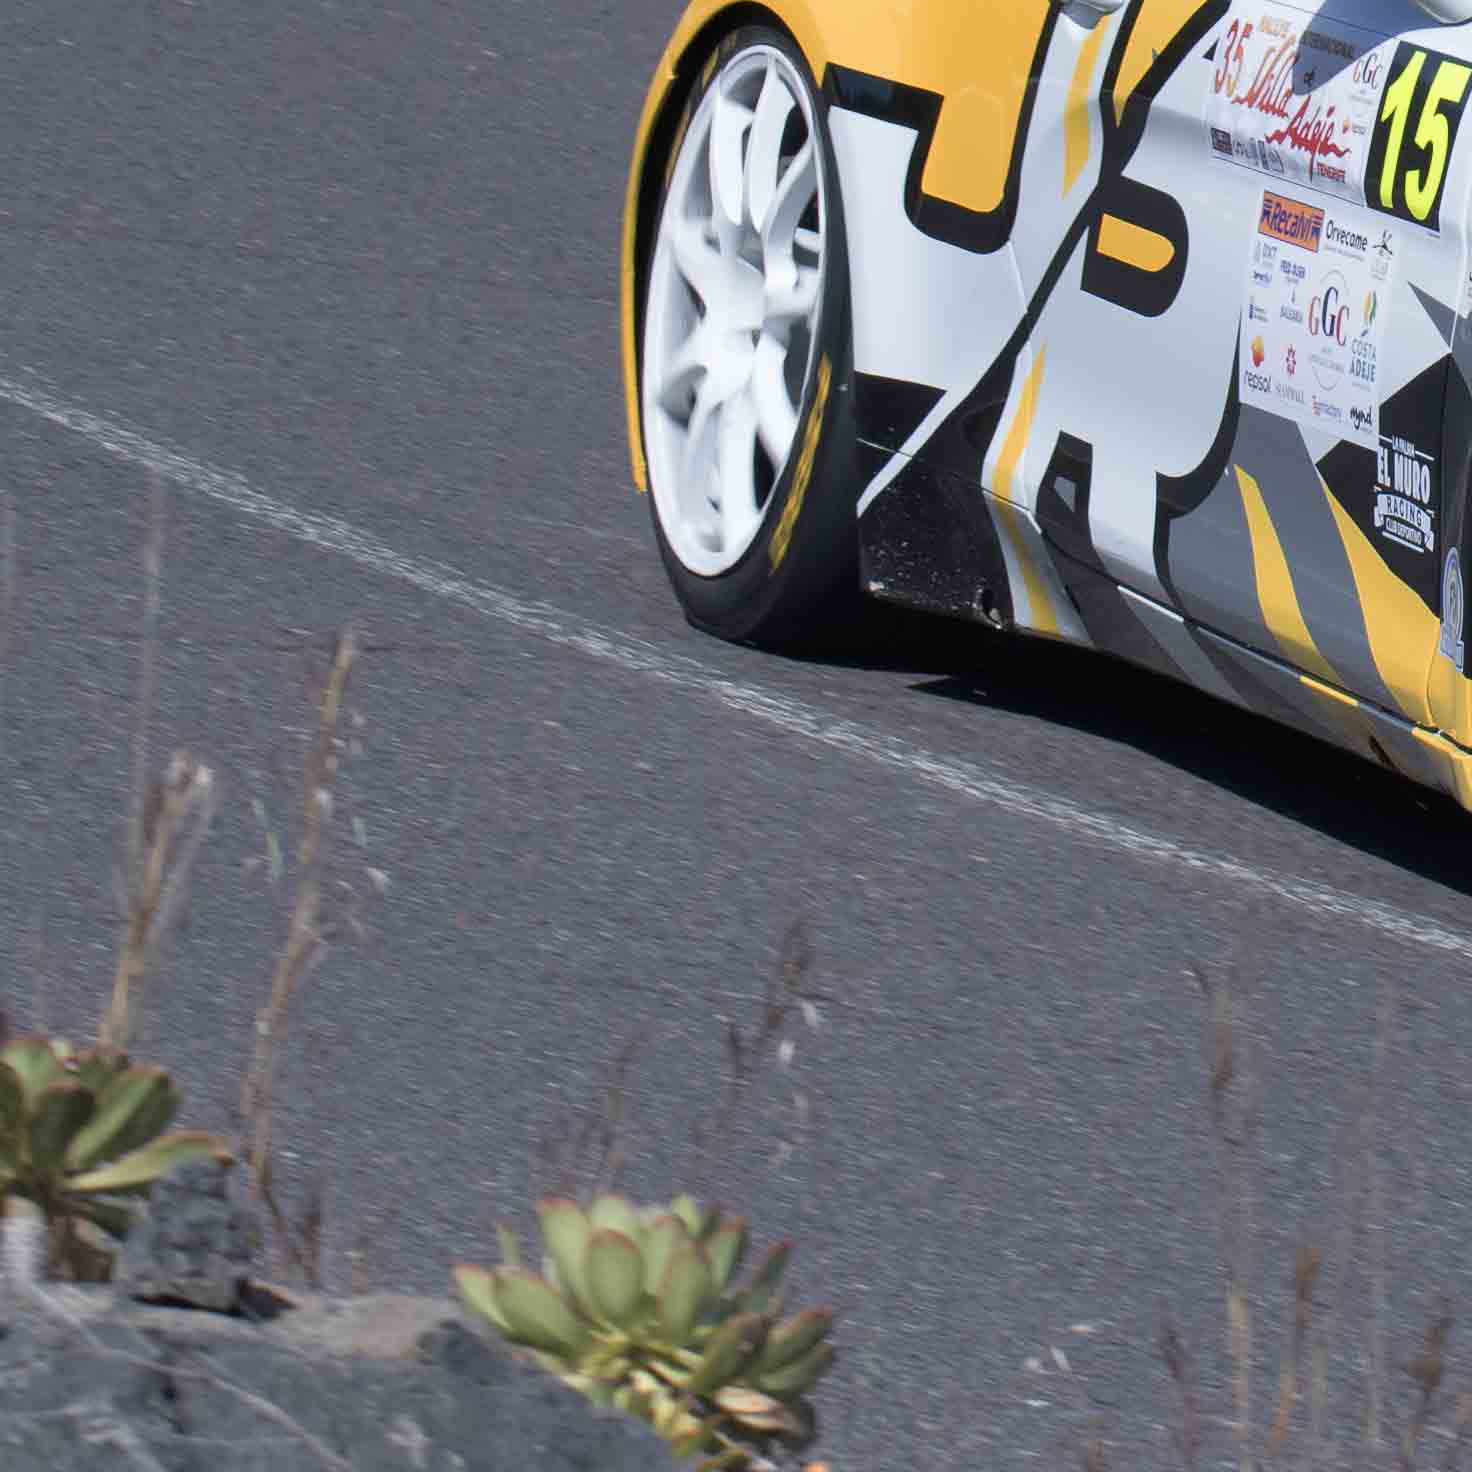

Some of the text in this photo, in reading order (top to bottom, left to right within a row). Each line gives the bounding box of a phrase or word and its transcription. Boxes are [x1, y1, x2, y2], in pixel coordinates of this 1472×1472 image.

[1381, 50, 1472, 221] 15
[1351, 337, 1377, 362] COSTA
[1244, 369, 1272, 393] repsol
[1350, 357, 1376, 383] ADEJE
[1376, 446, 1431, 505] EL MURO
[1385, 495, 1423, 528] RACING
